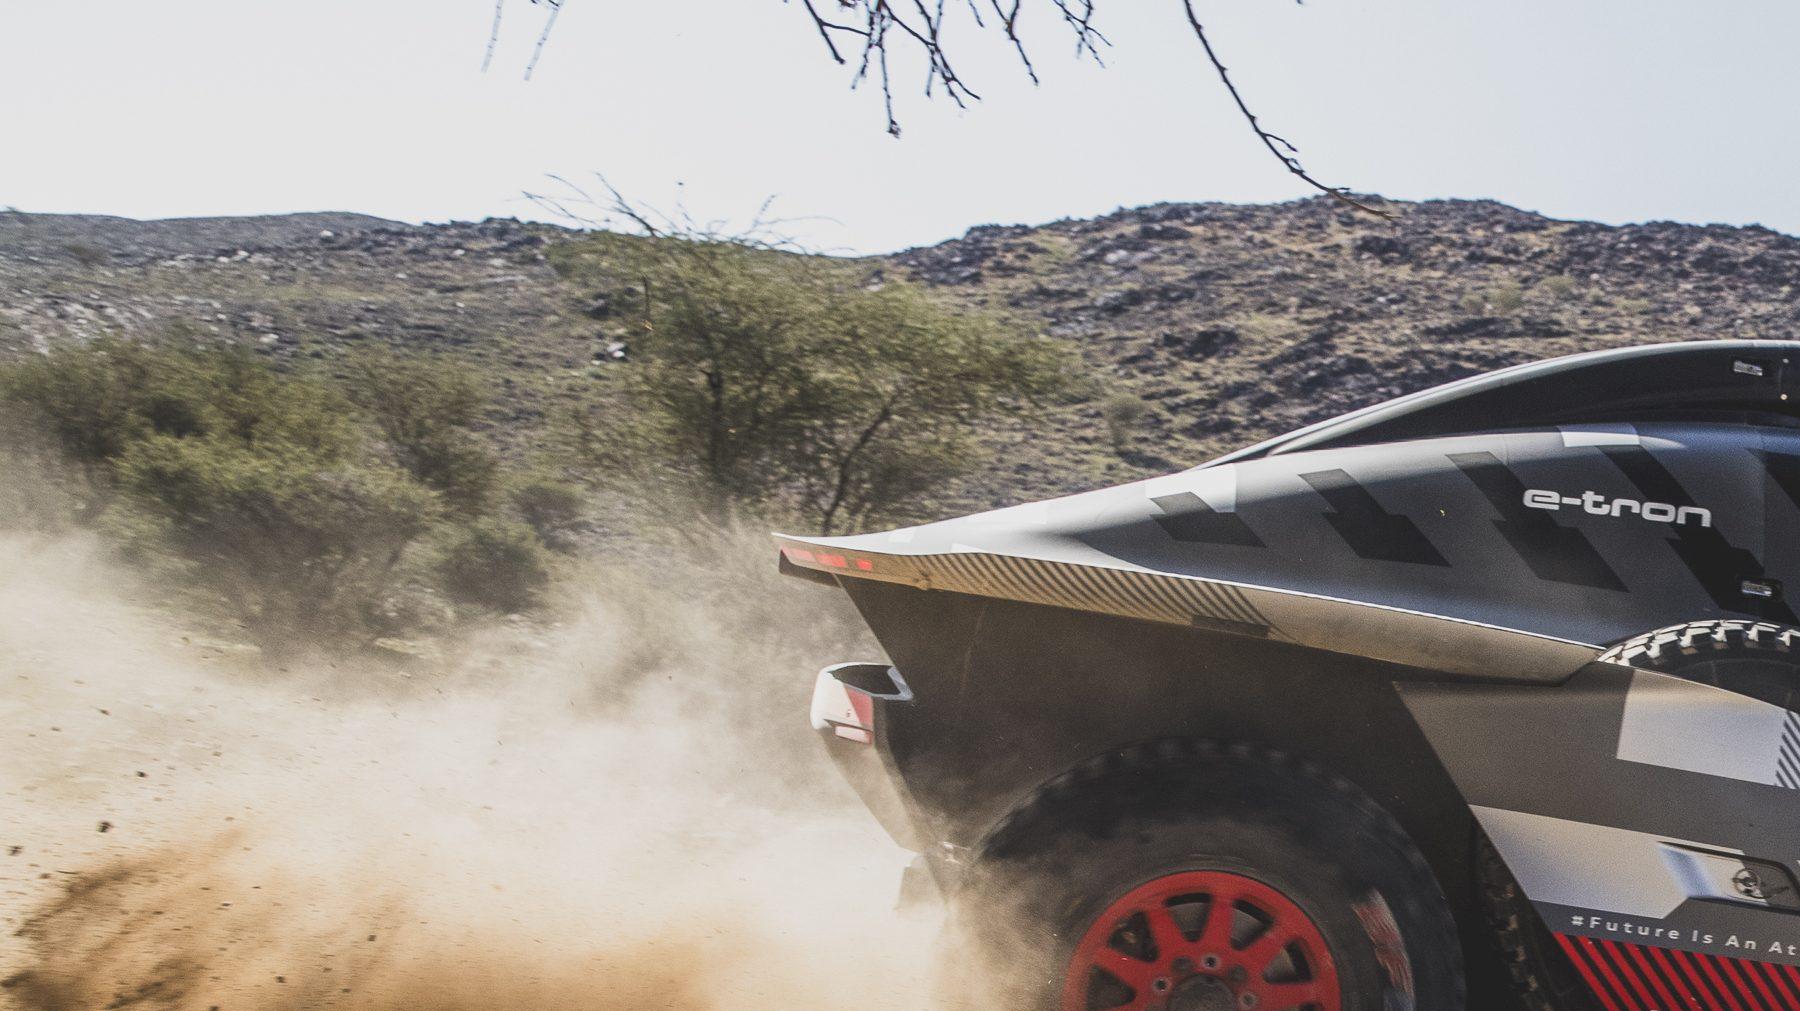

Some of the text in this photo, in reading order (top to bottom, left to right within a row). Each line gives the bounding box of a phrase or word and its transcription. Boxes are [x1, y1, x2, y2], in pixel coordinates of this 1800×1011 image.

[1523, 488, 1712, 528] e-tron
[1571, 915, 1680, 940] #Future
[1691, 930, 1713, 944] Is
[1725, 935, 1757, 950] An
